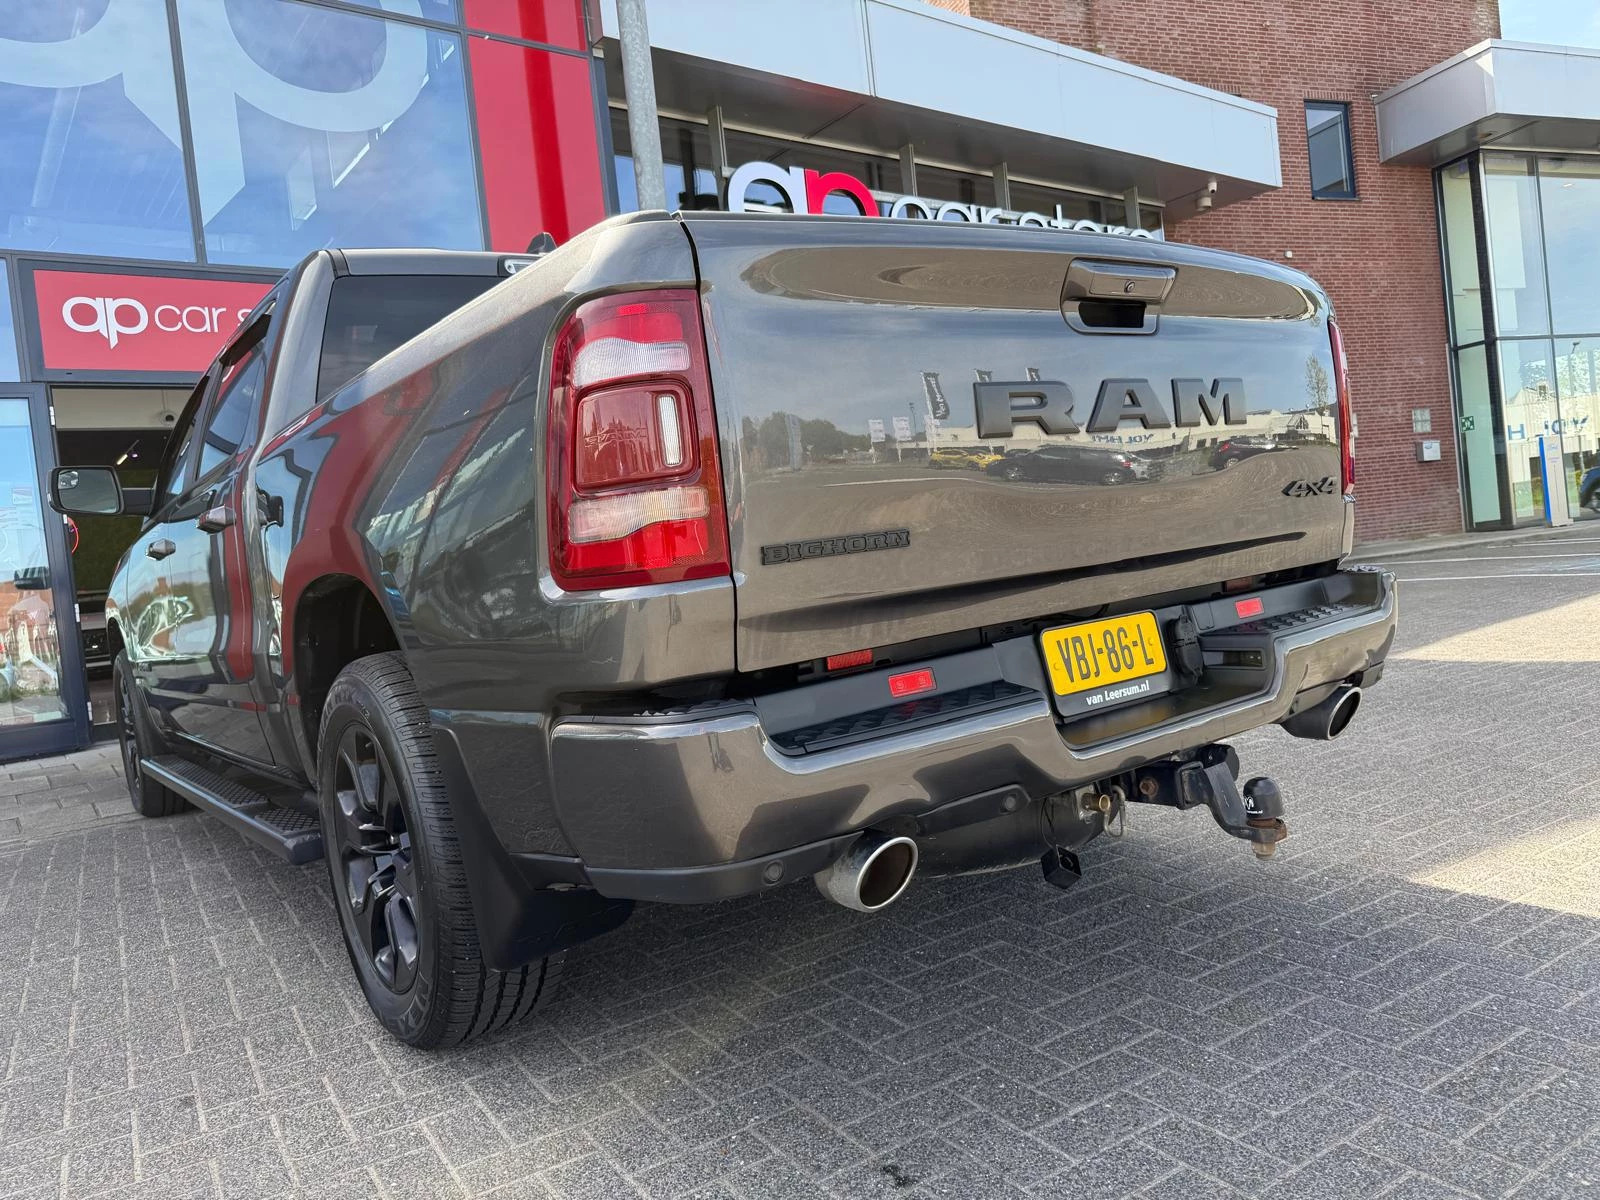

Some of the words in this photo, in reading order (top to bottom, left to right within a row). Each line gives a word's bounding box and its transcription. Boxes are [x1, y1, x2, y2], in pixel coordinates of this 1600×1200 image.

[62, 296, 149, 350] ap
[154, 304, 227, 333] car
[973, 378, 1248, 439] RAM
[760, 529, 911, 566] BIGHORN
[1056, 624, 1155, 683] VBJ-86-L
[1086, 693, 1104, 706] van
[1104, 680, 1150, 701] Leersum.nl
